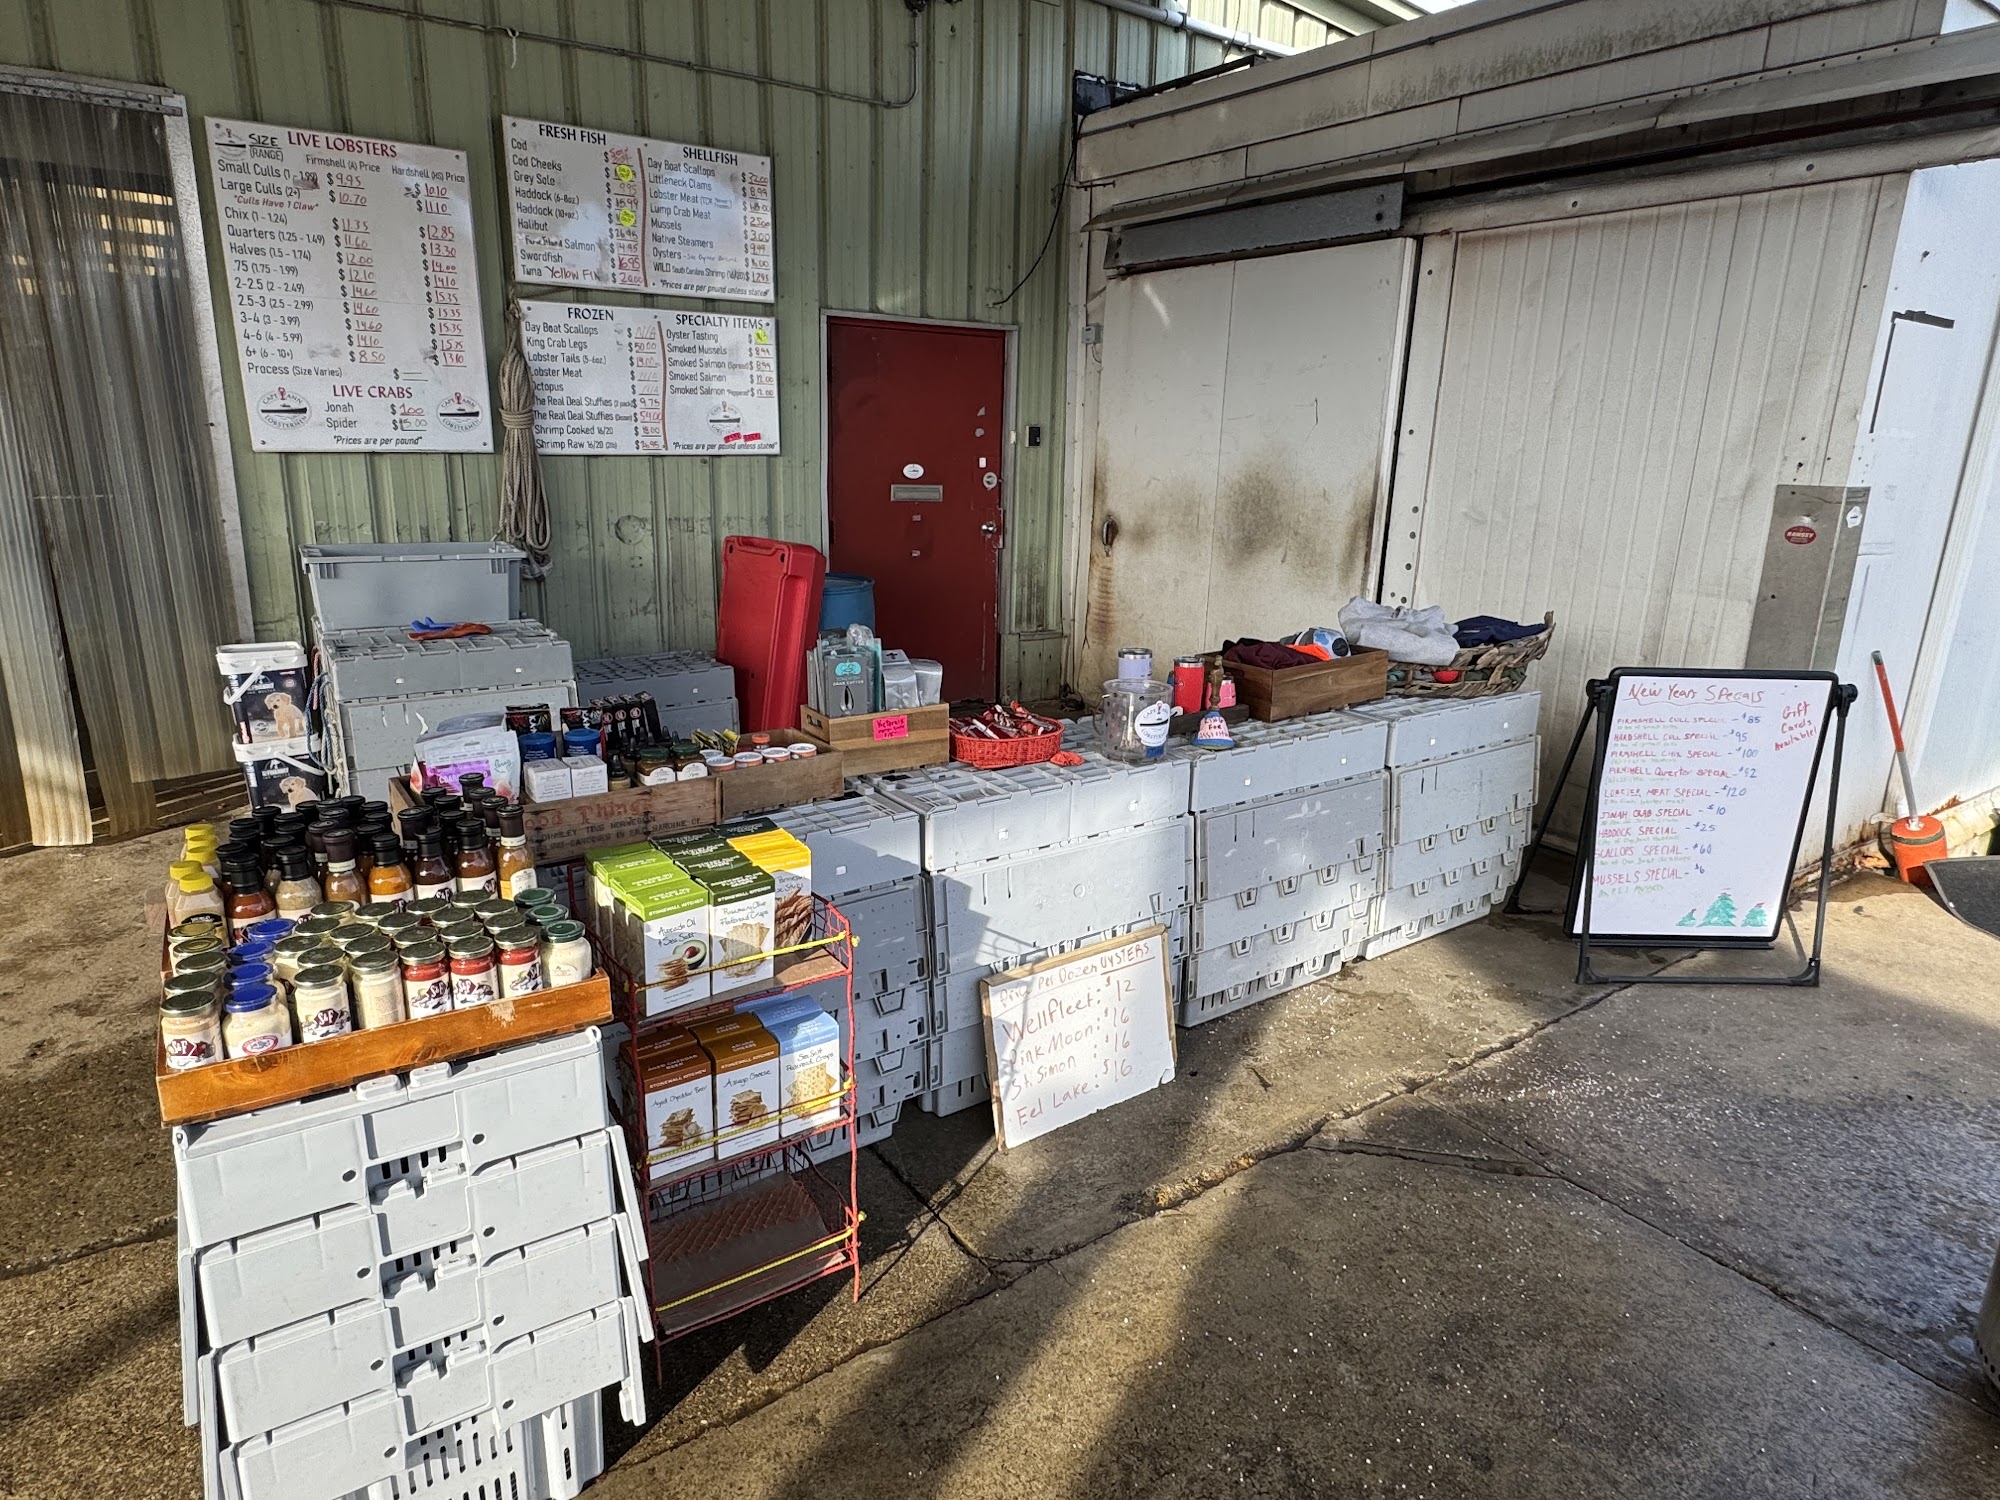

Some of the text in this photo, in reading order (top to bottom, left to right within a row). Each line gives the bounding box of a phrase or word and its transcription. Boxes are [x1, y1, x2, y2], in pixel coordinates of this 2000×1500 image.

[249, 133, 279, 147] SIZE
[538, 124, 606, 146] FRESH FISH
[287, 131, 397, 158] LIVE LOBSTERS
[511, 138, 527, 151] Cod
[250, 148, 283, 162] (RANGE)
[682, 146, 738, 166] SHELLFISH
[217, 159, 282, 179] Small Culls
[306, 154, 346, 169] Firmshell
[360, 161, 380, 173] Price
[512, 154, 562, 172] Cod Cheeks
[647, 157, 716, 179] Day Boat Scallops
[392, 165, 430, 180] Hardshell
[446, 172, 466, 184] Price
[513, 170, 556, 187] Grey Sole
[648, 172, 712, 191] Littleneck Clams
[220, 177, 252, 194] Large
[255, 181, 282, 197] Culls
[515, 186, 552, 201] Haddock
[262, 197, 284, 208] Have
[649, 187, 698, 203] Lobster Meat
[224, 206, 249, 220] Chix
[516, 202, 553, 217] Haddock
[650, 203, 671, 218] Lump
[673, 205, 691, 218] Crab
[693, 209, 712, 220] Meat
[517, 218, 548, 231] Halibut
[651, 218, 682, 231] Mussels
[227, 224, 275, 241] Quarters
[564, 238, 596, 252] Salmon
[651, 232, 714, 249] Native Steamers
[230, 242, 267, 256] Halves
[520, 249, 563, 264] Swordfish
[652, 247, 682, 261] Oysters
[521, 264, 542, 277] Tuna
[567, 307, 614, 321] FROZEN
[525, 321, 599, 338] Day Boat Scallops
[675, 314, 763, 330] SPECIALTY ITEMS
[666, 328, 719, 344] Oyster Tasting
[526, 336, 588, 352] King Crab Legs
[667, 343, 727, 356] Smoked Mussels
[527, 351, 581, 364] Lobster Tails
[668, 357, 726, 369] Smoked Salmon
[247, 362, 343, 379] Process (Size Varies)
[562, 367, 583, 379] Meat
[669, 370, 727, 383] Smoked Salmon
[332, 385, 413, 399] LIVE CRABS
[670, 384, 699, 396] Smoked
[324, 401, 355, 413] Jonah
[534, 410, 614, 422] The Real Deal Stuffies
[326, 417, 358, 431] Spider
[534, 425, 564, 436] Shrimp
[566, 425, 596, 435] Cooked
[364, 437, 393, 447] are per
[536, 439, 585, 451] Shrimp Raw
[1782, 701, 1811, 720] Gift
[1058, 964, 1098, 983] Dozen
[1009, 1042, 1045, 1072] Pink
[1036, 1055, 1077, 1084] Simon
[1016, 1097, 1042, 1126] Eel
